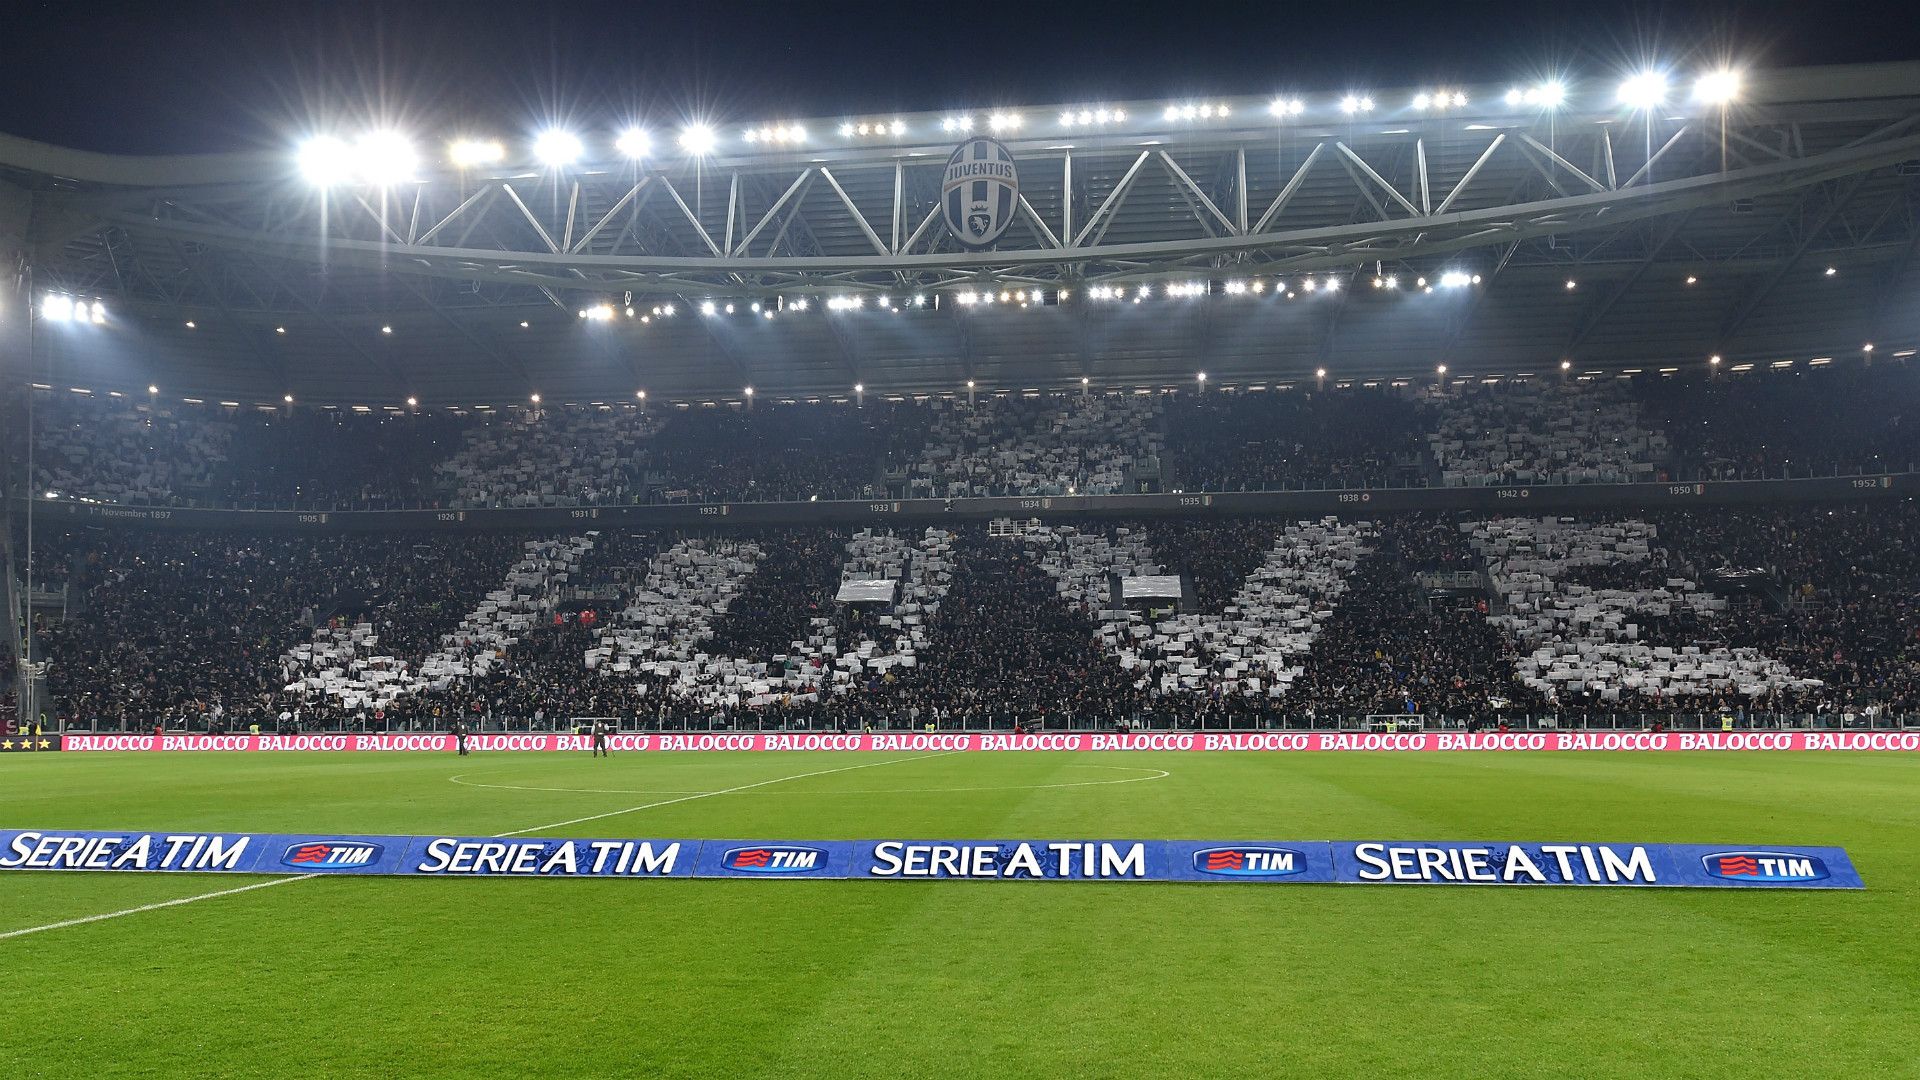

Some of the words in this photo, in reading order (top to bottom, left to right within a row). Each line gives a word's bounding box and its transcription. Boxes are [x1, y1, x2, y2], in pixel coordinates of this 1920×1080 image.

[949, 162, 1012, 181] JUVENTUS
[1668, 486, 1690, 495] 1950
[1853, 479, 1877, 488] 1952
[1179, 497, 1200, 505] 1935
[1338, 493, 1359, 502] 1938
[1496, 489, 1517, 498] 1942
[699, 507, 718, 515] 1932
[870, 504, 889, 512] 1933
[1020, 500, 1040, 508] 1934
[101, 507, 147, 518] Novembre
[150, 510, 172, 519] 1897
[298, 514, 318, 523] 1905
[437, 513, 455, 521] 1926
[571, 510, 589, 518] 1931
[68, 736, 153, 751] BALOCCO
[162, 736, 249, 751] BALOCCO
[258, 736, 347, 751] BALOCCO
[356, 735, 446, 751] BALOCCO
[659, 735, 755, 751] BALOCCO
[764, 735, 861, 751] BALOCCO
[871, 735, 970, 751] BALOCCO
[980, 734, 1081, 750] BALOCCO
[1091, 734, 1194, 750] BALOCCO
[1204, 734, 1310, 750] BALOCCO
[1319, 734, 1426, 750] BALOCCO
[1437, 733, 1546, 750] BALOCCO
[1557, 733, 1668, 750] BALOCCO
[1679, 733, 1793, 750] BALOCCO
[1803, 733, 1920, 750] BALOCCO
[0, 832, 122, 867] SERIE
[111, 835, 150, 868] A
[160, 836, 250, 869] TIM
[328, 847, 374, 864] TIM
[418, 838, 544, 872] SERIE
[541, 840, 576, 873] A
[591, 841, 681, 873] TIM
[871, 841, 999, 875] SERIE
[1004, 842, 1044, 876] A
[1048, 843, 1145, 876] TIM
[771, 851, 817, 868] TIM
[1245, 853, 1293, 870] TIM
[1355, 843, 1496, 880] SERIE
[1503, 845, 1547, 881] A
[1542, 845, 1656, 882] TIM
[1758, 858, 1815, 877] TIM
